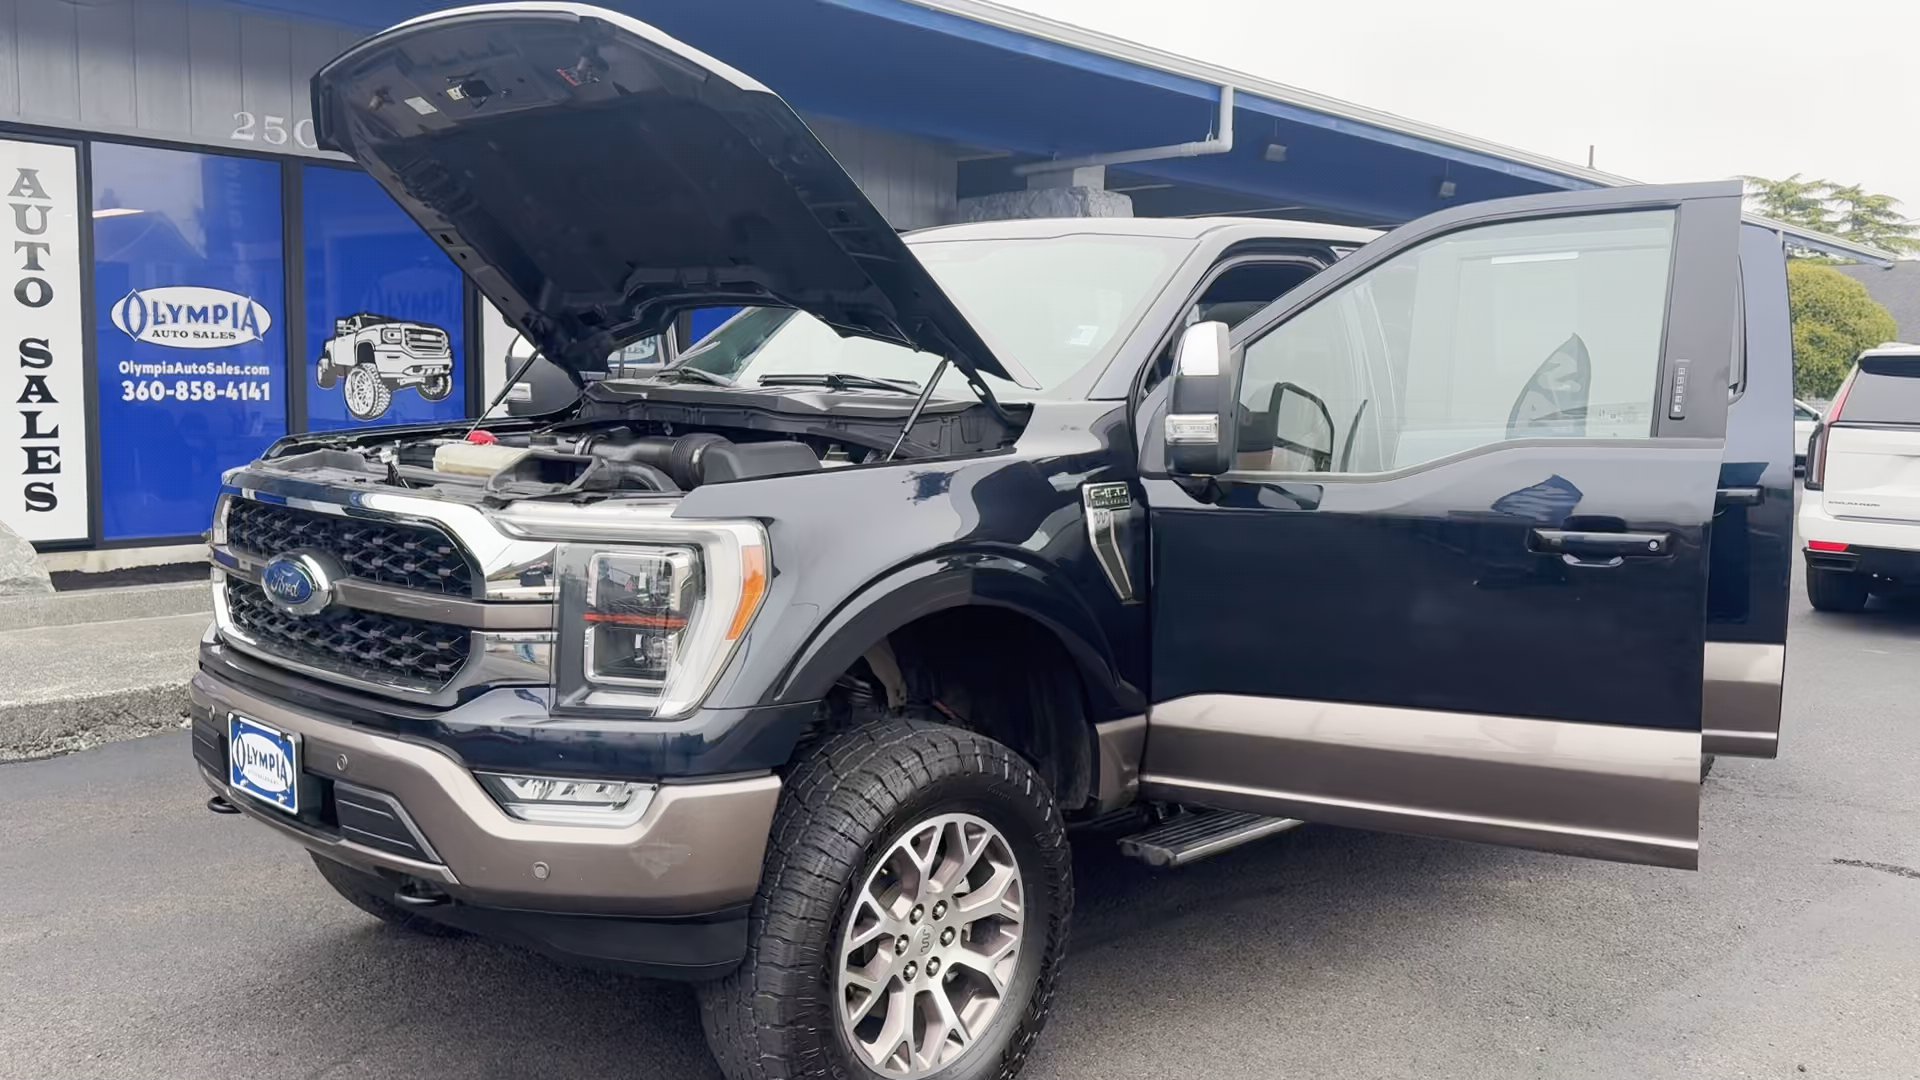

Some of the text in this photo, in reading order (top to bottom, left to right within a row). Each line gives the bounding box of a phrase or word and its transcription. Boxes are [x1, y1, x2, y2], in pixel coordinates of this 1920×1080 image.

[121, 289, 262, 339] OLYMPIA
[7, 167, 61, 512] AUTO SALES
[152, 330, 236, 340] AUTO SALES
[119, 361, 269, 377] OlympiaAutoSales.com
[122, 380, 270, 401] 360-858-4141
[269, 571, 301, 598] Ford
[236, 732, 290, 790] OLYMPIA
